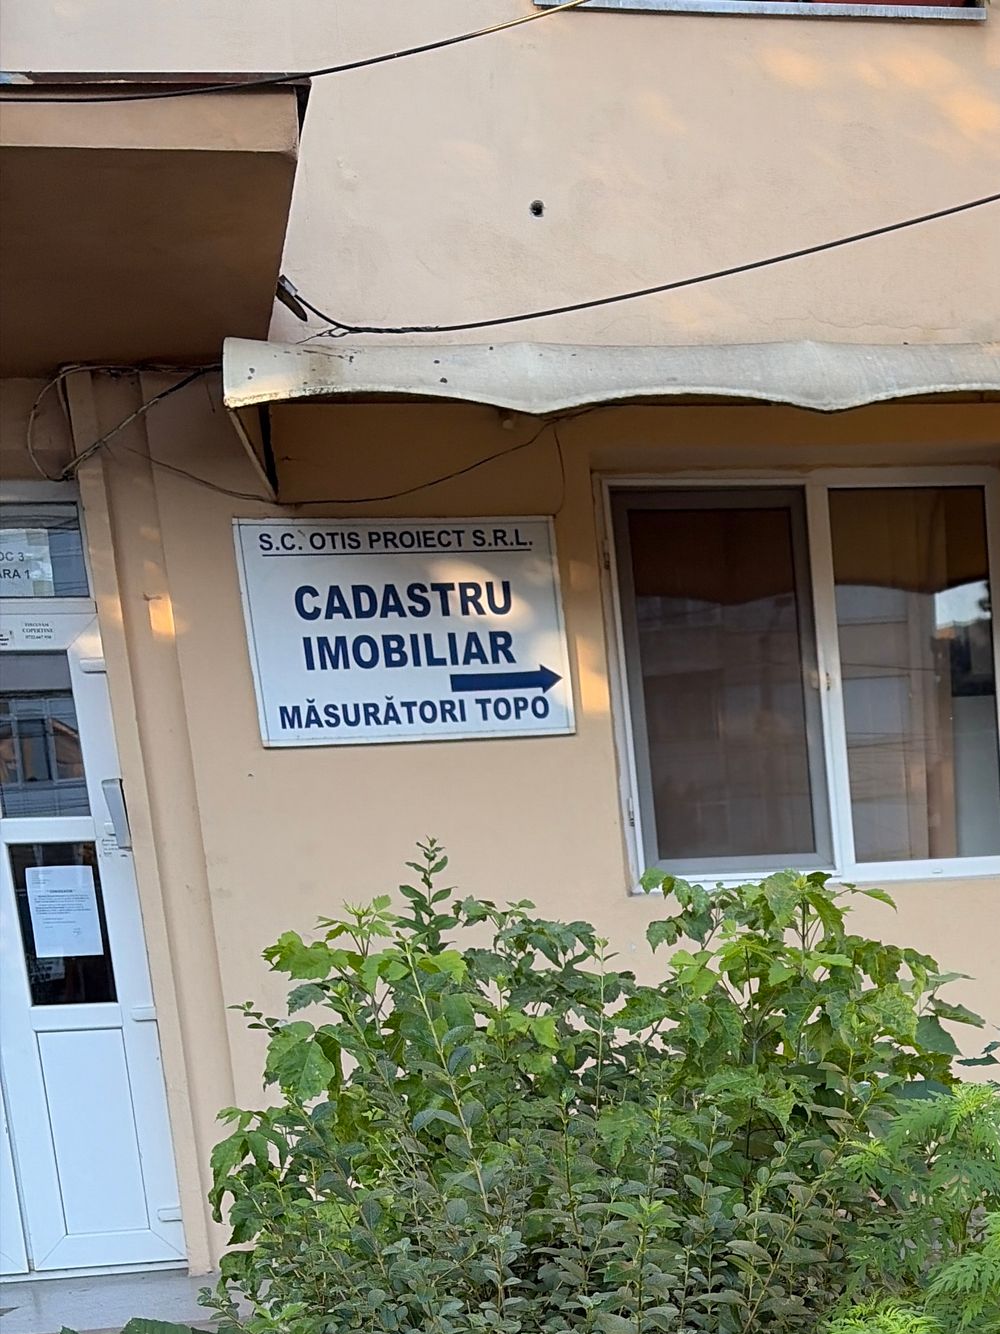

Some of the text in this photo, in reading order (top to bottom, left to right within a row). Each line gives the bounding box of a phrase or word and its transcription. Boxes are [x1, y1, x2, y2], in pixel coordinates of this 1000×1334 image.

[259, 528, 533, 551] S.C. OTIS PROIECT S.R.L.
[18, 552, 25, 562] 3
[0, 569, 30, 580] RA 1
[294, 580, 513, 621] CADASTRU
[302, 630, 517, 671] IMOBILIAR
[279, 695, 550, 729] MĂSURĂTORI TOPO
